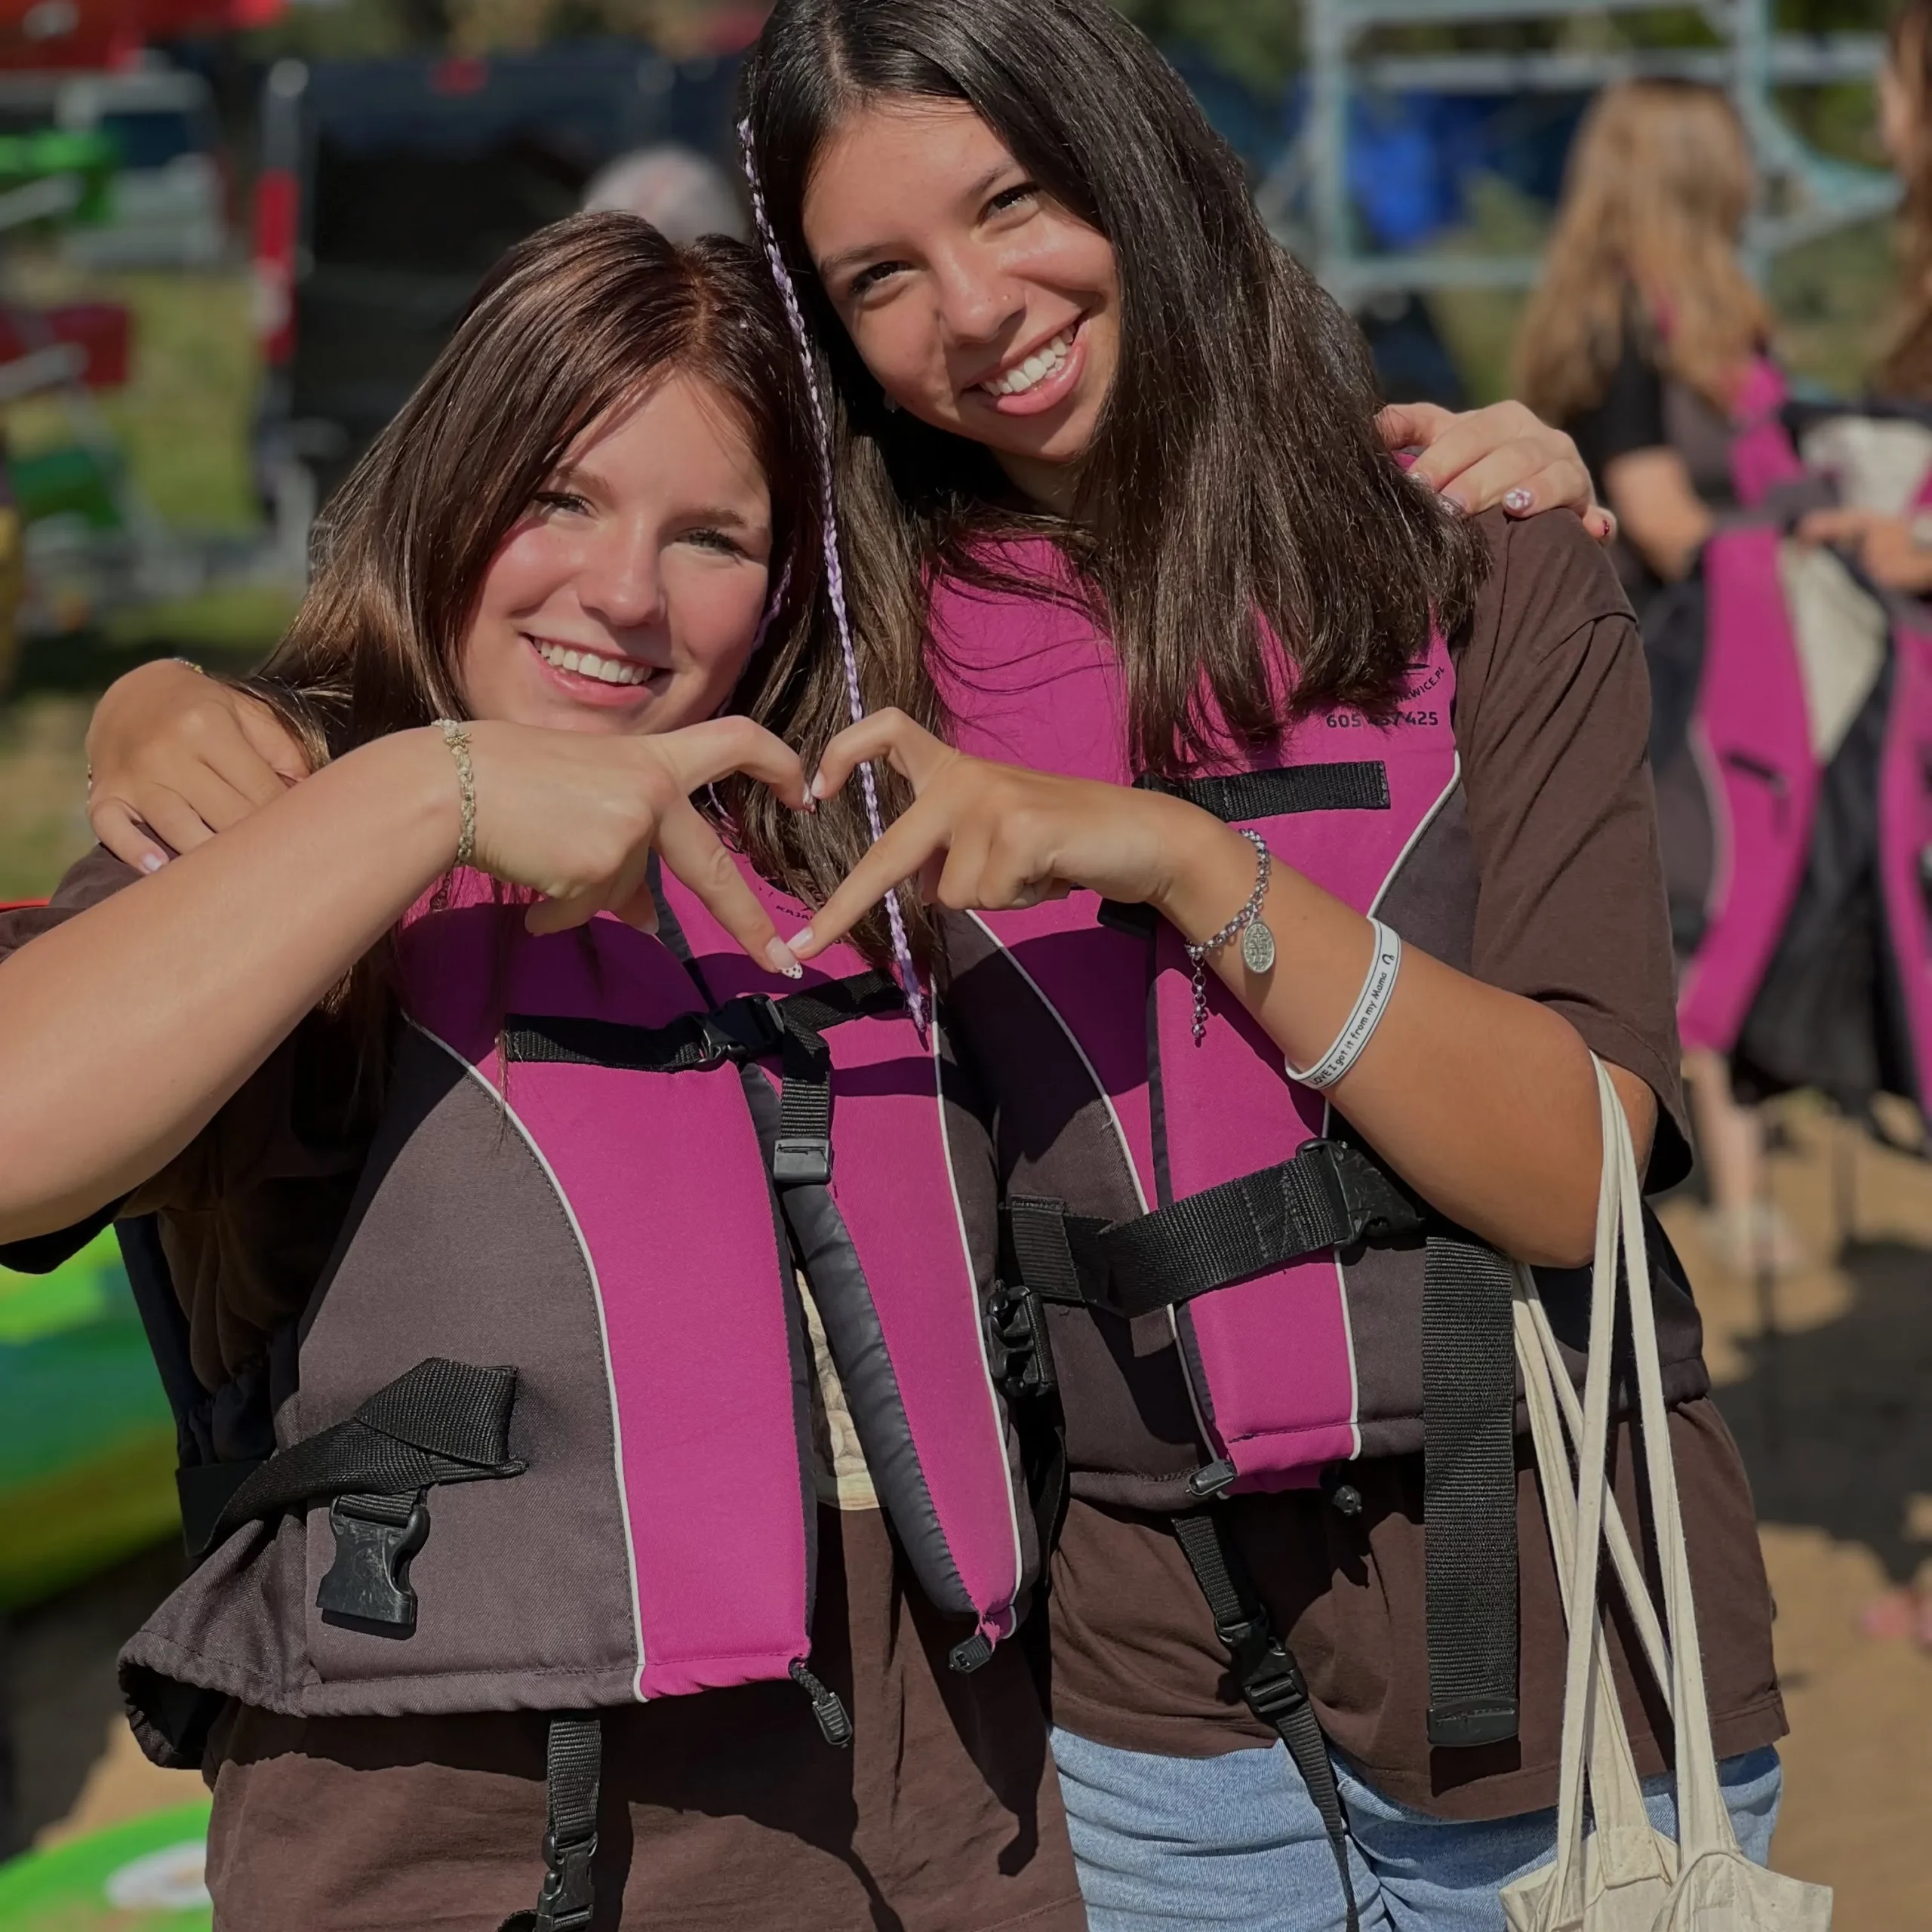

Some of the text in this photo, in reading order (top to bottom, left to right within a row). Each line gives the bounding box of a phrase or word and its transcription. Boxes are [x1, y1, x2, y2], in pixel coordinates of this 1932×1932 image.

[1326, 714, 1361, 728] 605
[776, 905, 813, 921] KAJA
[1309, 1069, 1332, 1085] LOVE
[1336, 1050, 1348, 1066] got
[1344, 1041, 1355, 1050] it
[1351, 1017, 1369, 1039] from
[1365, 1001, 1377, 1016] my
[1371, 972, 1387, 1000] Mama
